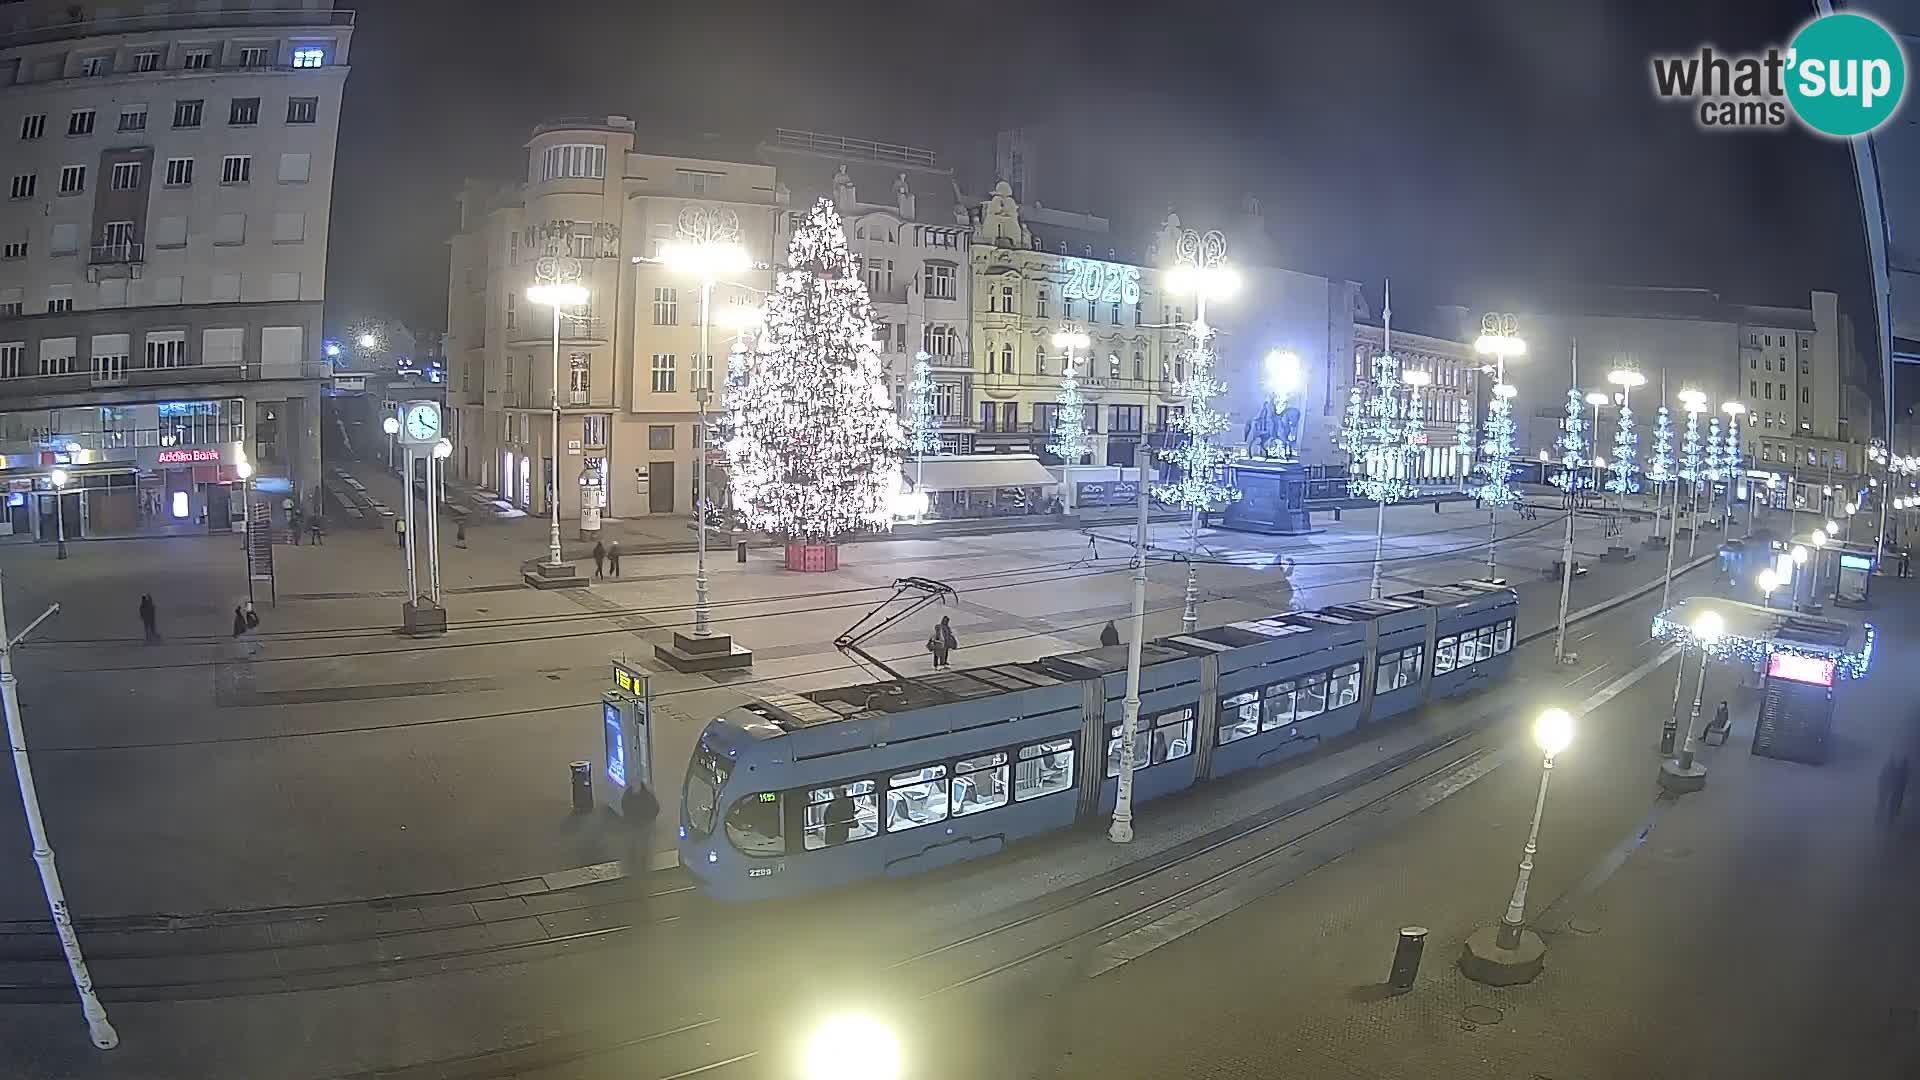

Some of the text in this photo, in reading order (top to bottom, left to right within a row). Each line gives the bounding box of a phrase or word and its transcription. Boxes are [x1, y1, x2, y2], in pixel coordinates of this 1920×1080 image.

[1063, 259, 1140, 304] 2026
[159, 449, 219, 462] Addiko Bank
